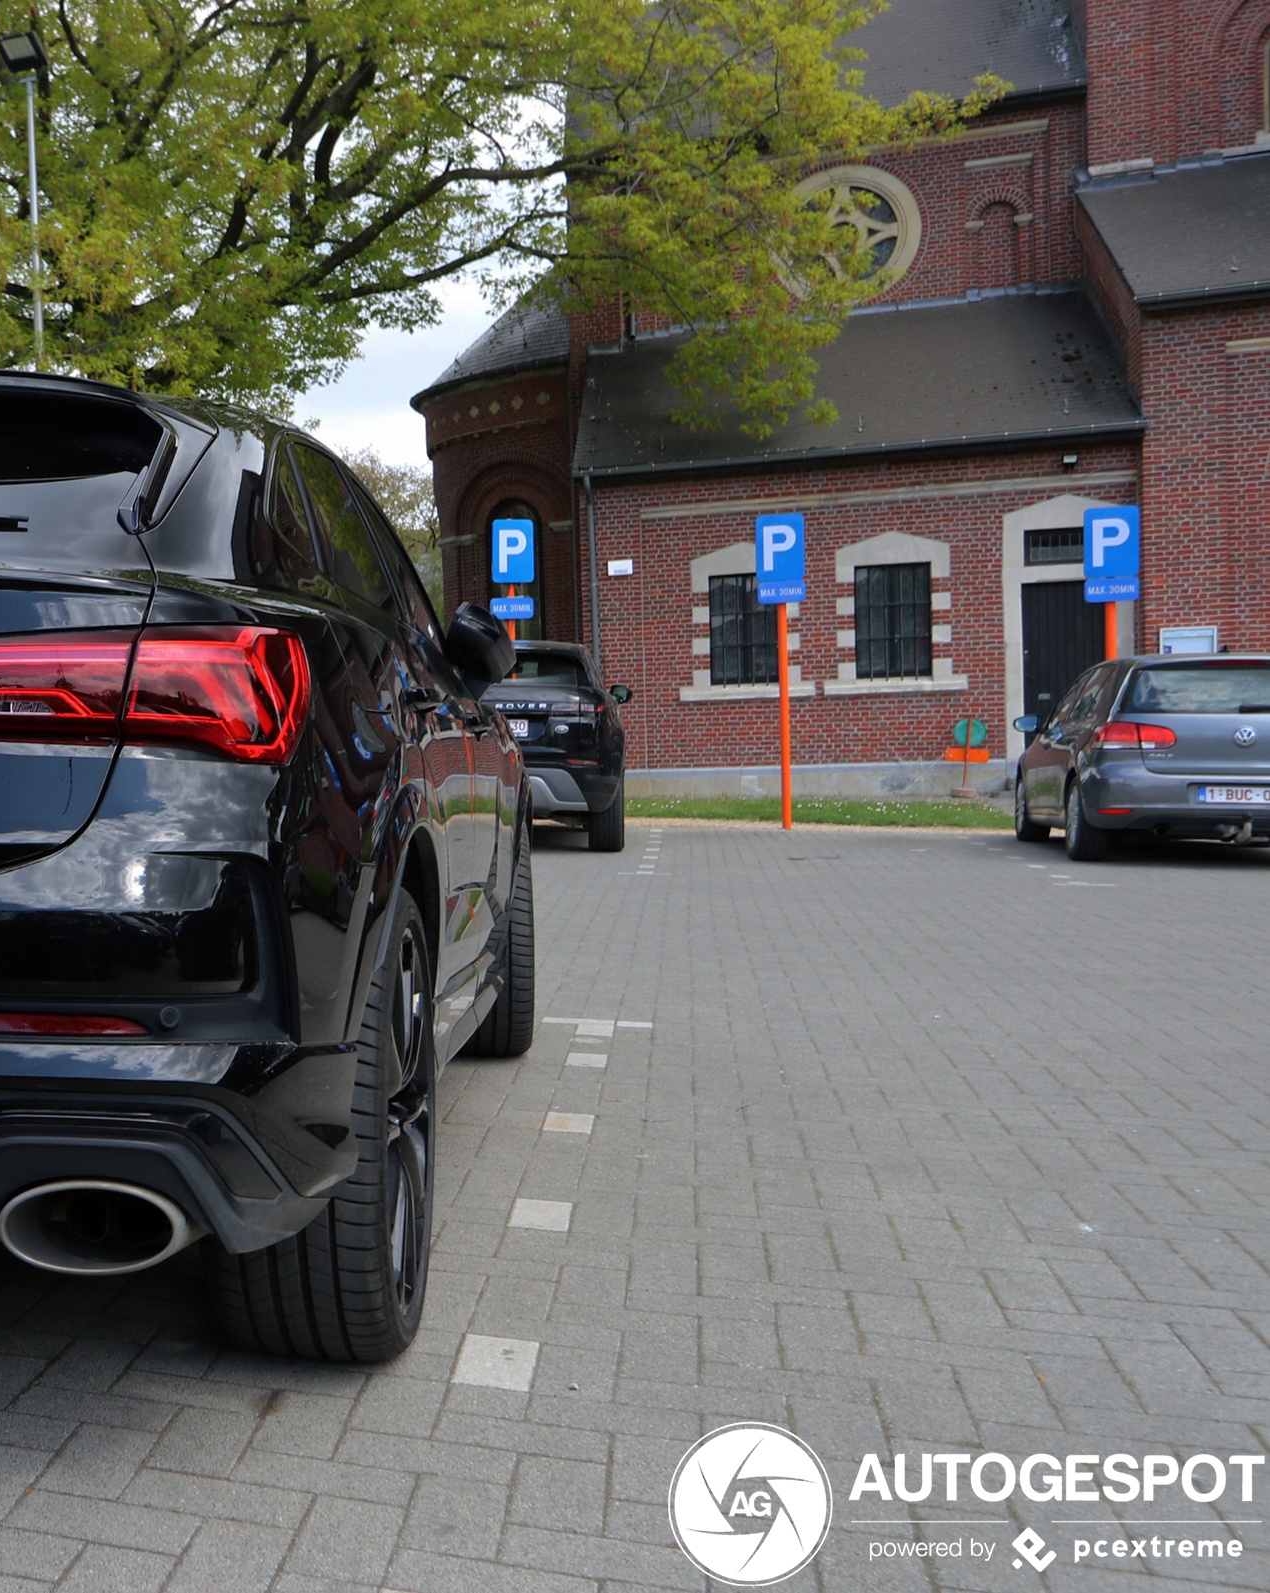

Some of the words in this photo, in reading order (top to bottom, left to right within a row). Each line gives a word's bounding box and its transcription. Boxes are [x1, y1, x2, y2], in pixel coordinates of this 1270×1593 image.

[498, 529, 527, 573] P
[763, 525, 796, 572] P
[1092, 518, 1130, 568] P
